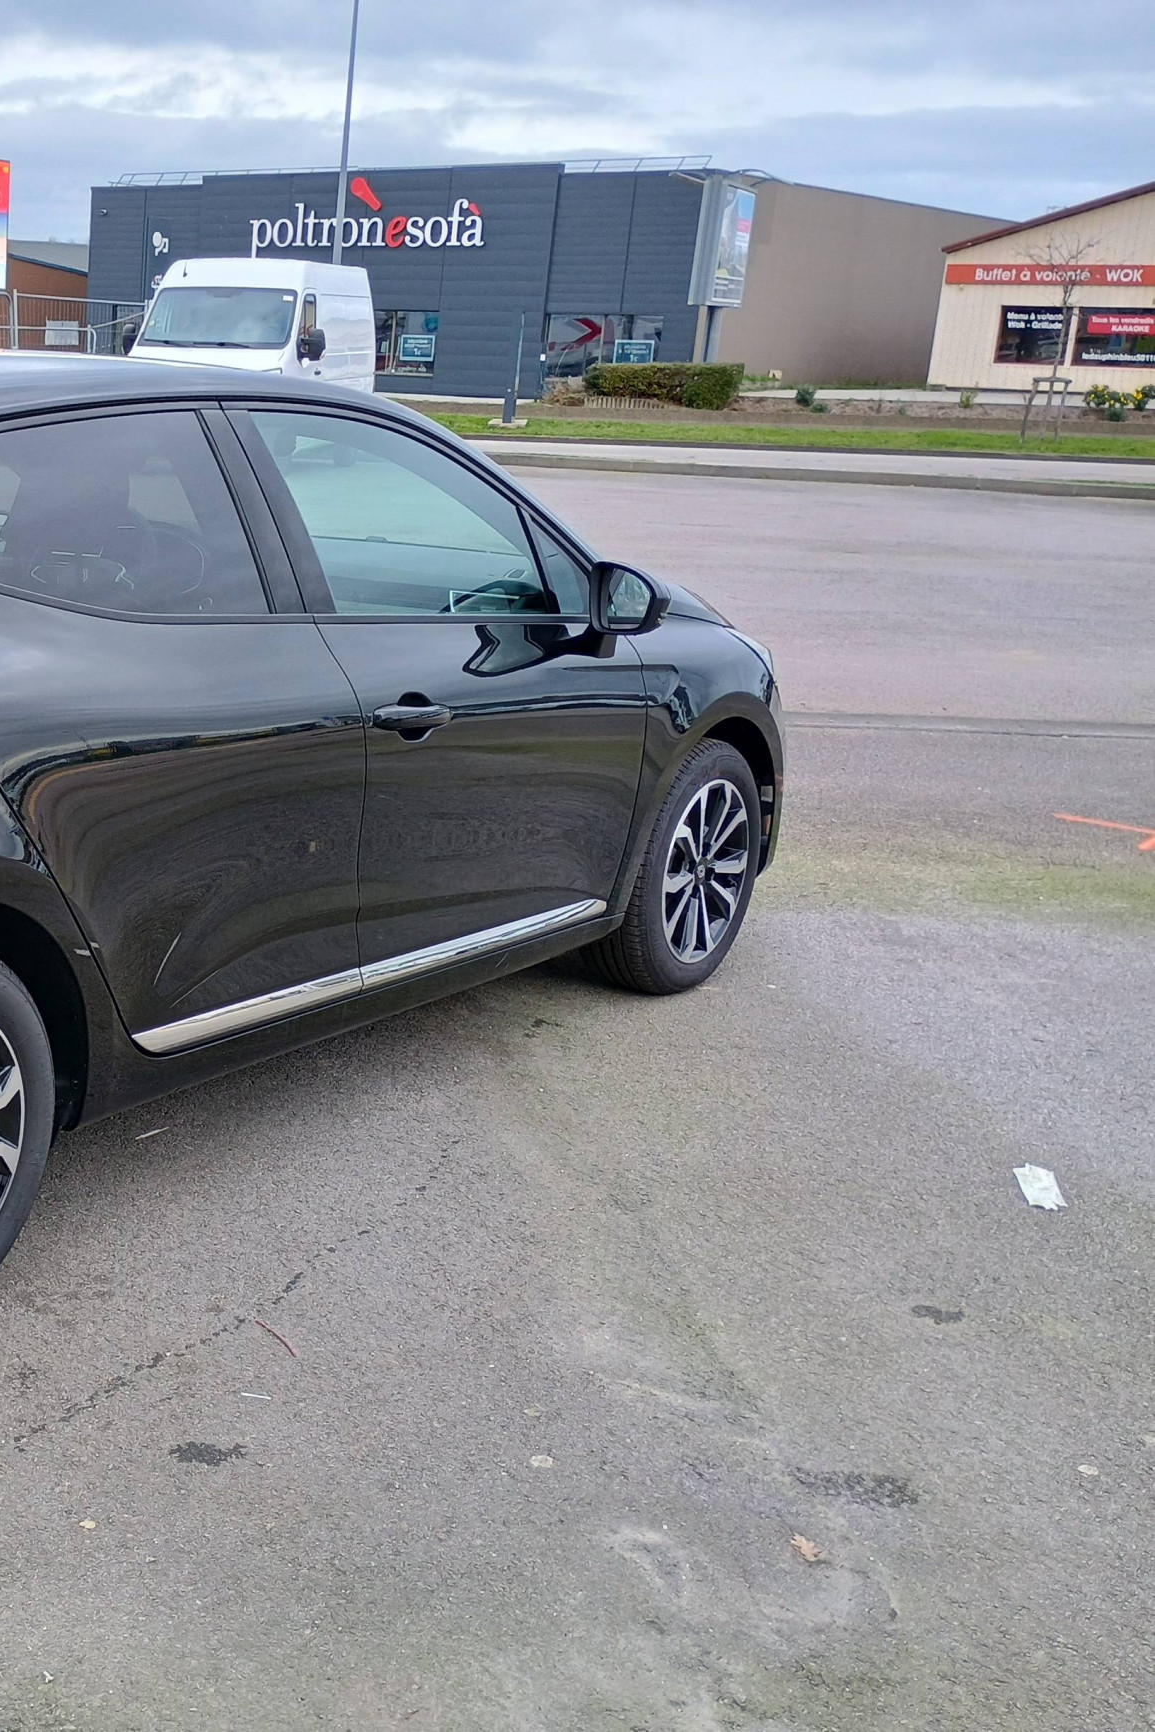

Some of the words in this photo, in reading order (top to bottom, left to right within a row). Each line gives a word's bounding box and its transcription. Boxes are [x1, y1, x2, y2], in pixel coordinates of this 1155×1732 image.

[975, 268, 1016, 281] Buffet
[1020, 268, 1031, 281] à
[1105, 268, 1144, 283] WOK
[1111, 325, 1150, 333] KARAOKE
